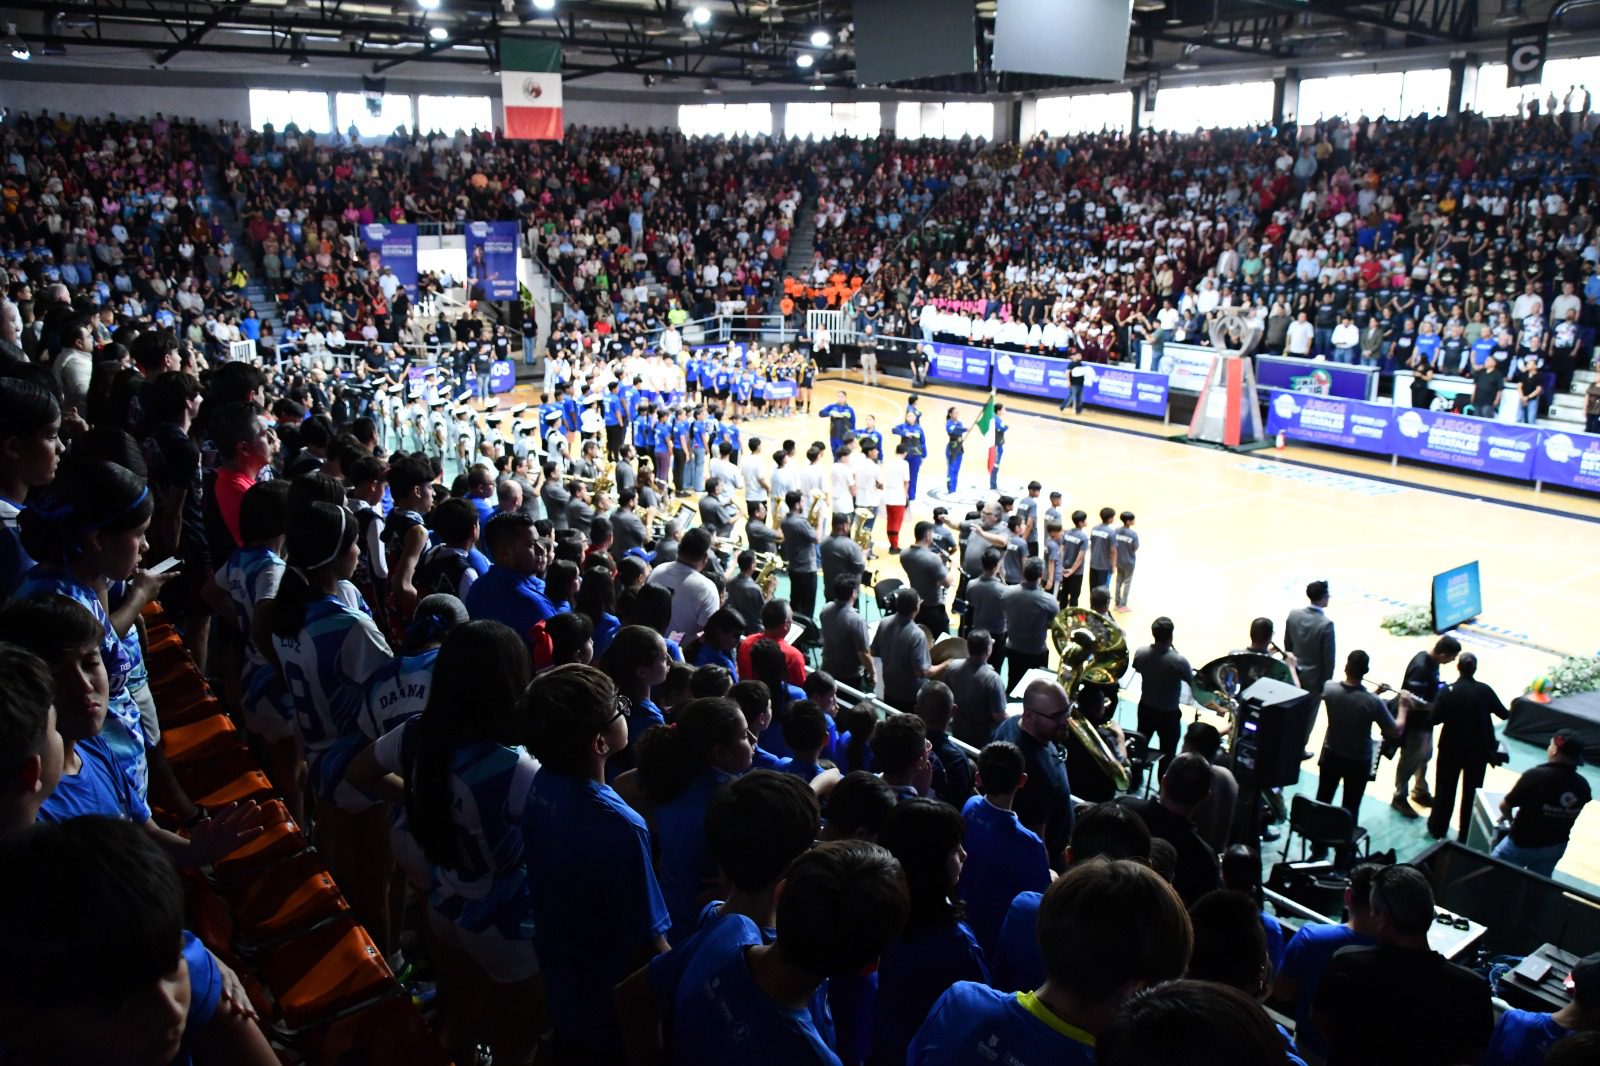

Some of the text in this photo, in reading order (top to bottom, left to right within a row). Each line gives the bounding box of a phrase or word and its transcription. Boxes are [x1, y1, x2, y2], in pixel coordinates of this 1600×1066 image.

[1512, 45, 1541, 72] C
[1303, 399, 1347, 414] JUEGOS
[1431, 418, 1482, 435] JUEGOS
[1451, 454, 1485, 467] CENTRO
